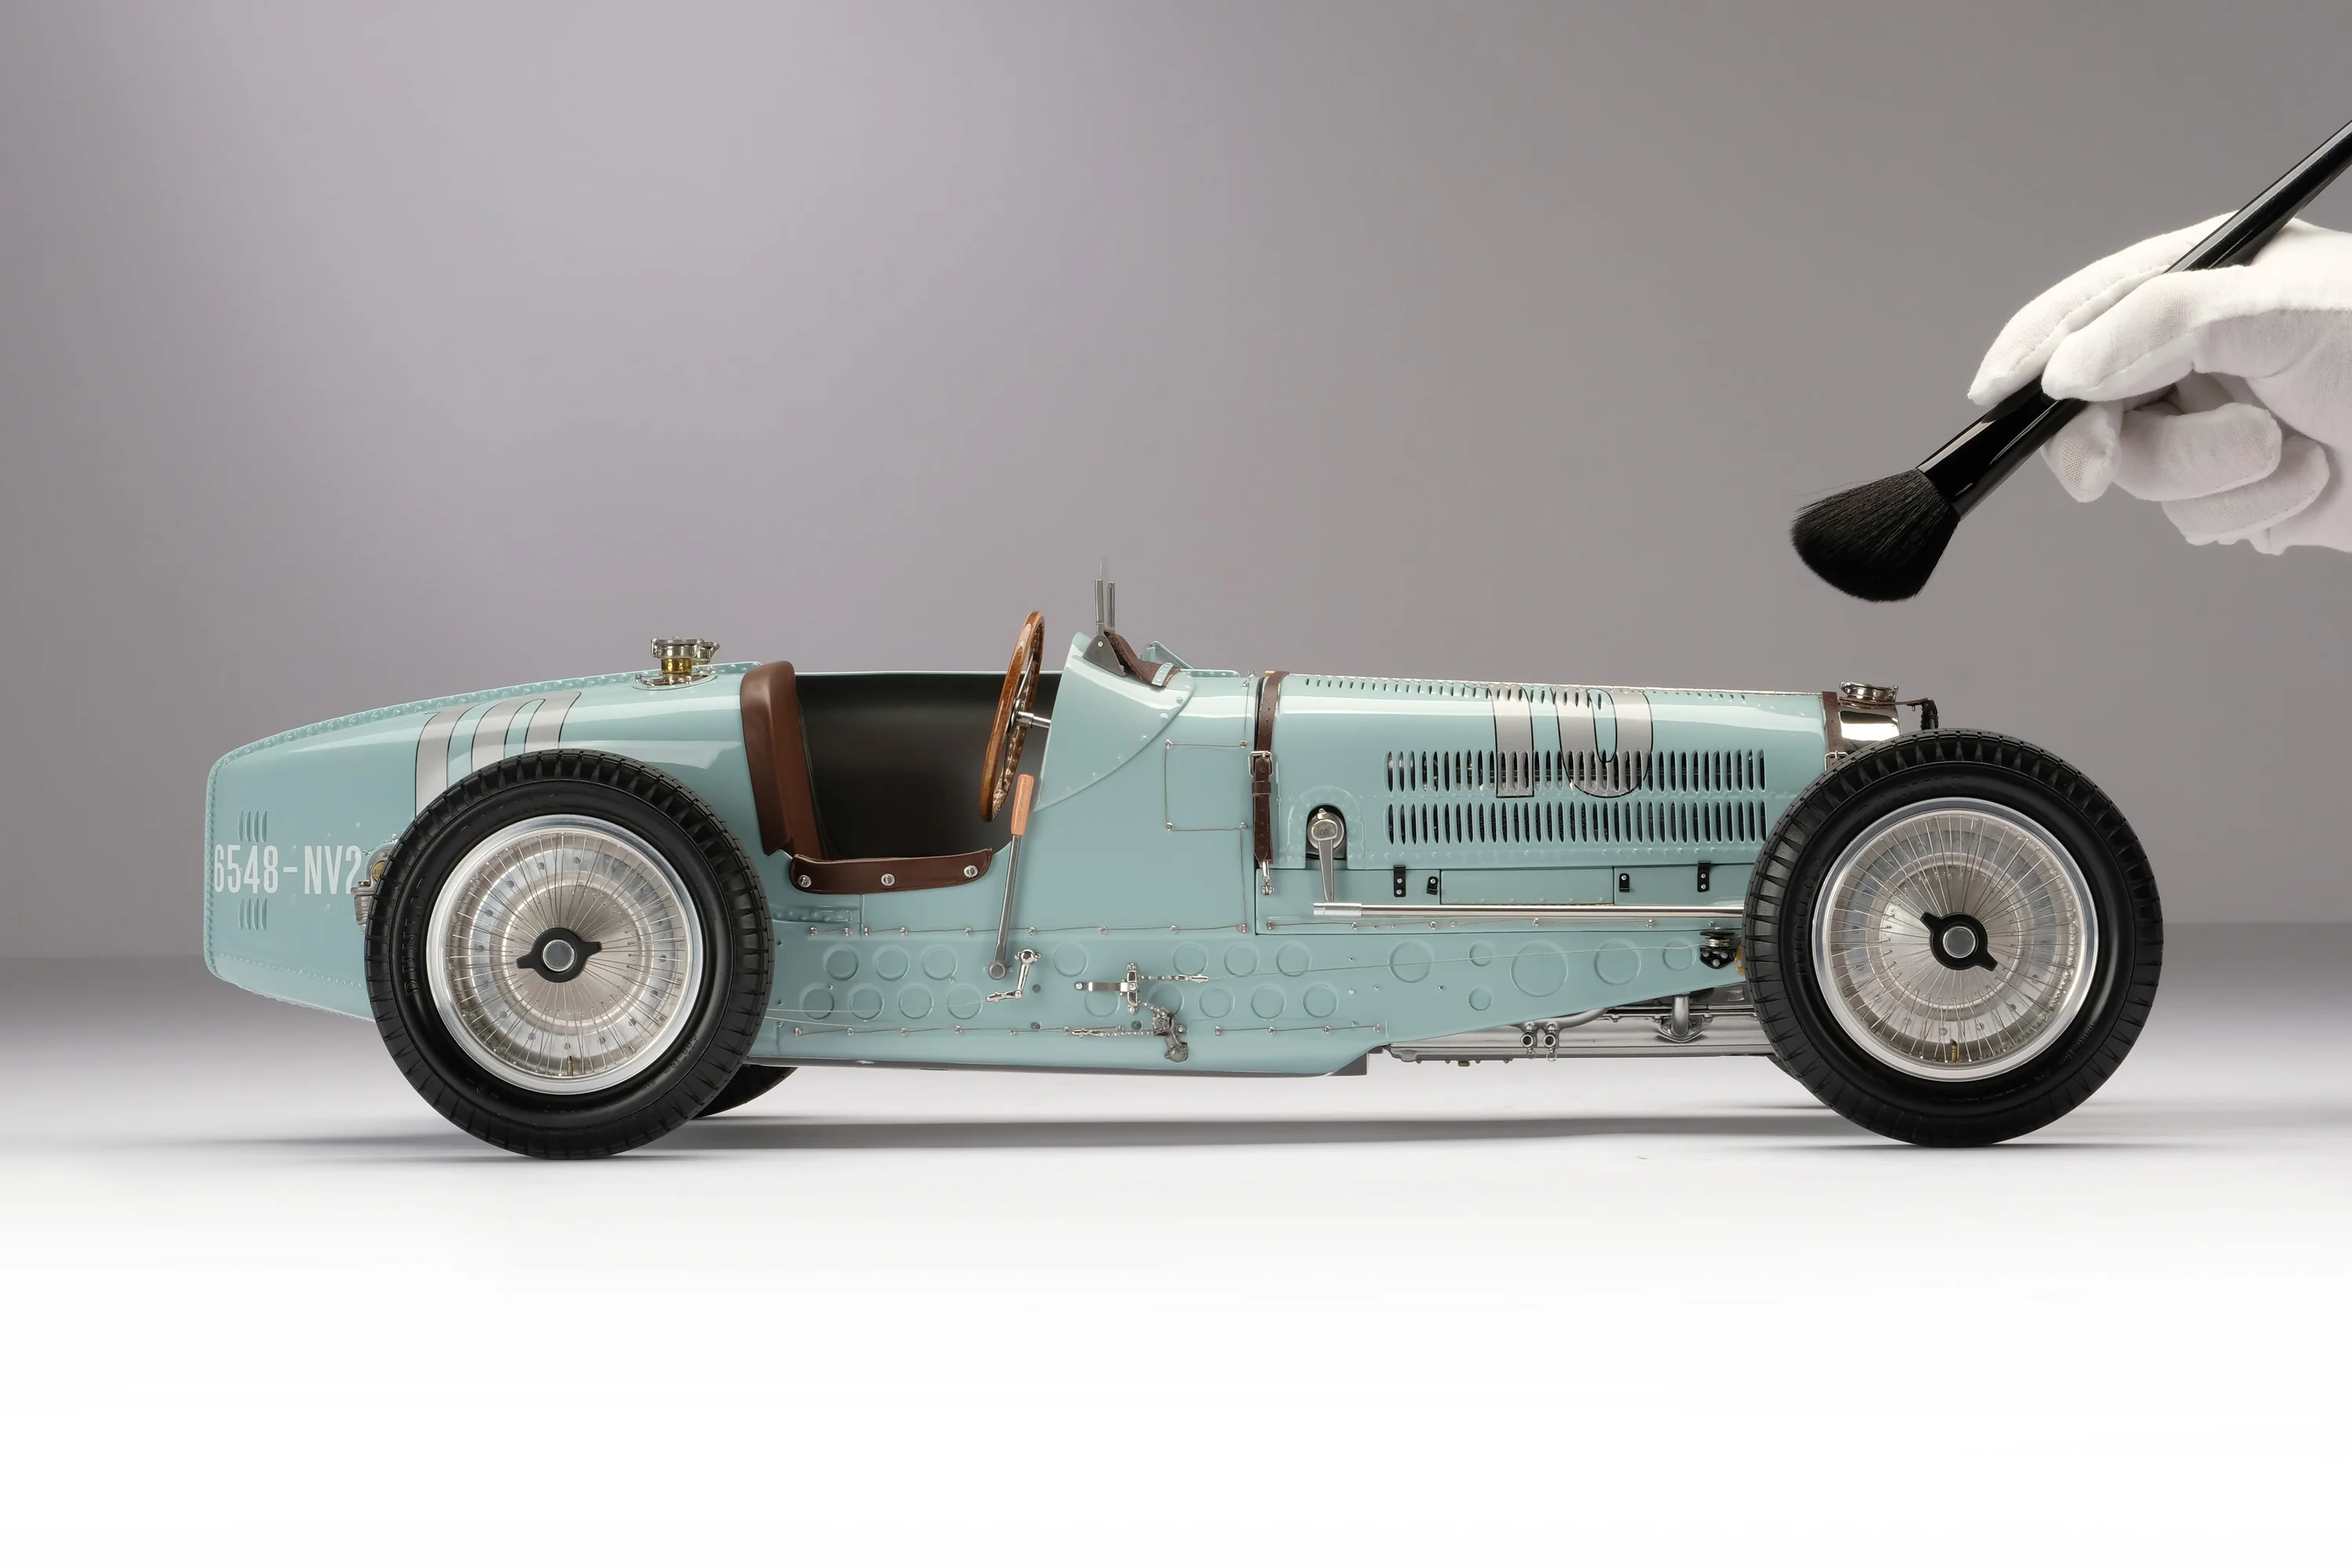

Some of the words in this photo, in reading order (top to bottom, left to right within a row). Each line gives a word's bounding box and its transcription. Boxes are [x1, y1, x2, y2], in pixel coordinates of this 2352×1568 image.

[1464, 681, 1653, 798] 10
[214, 844, 362, 895] 6548-NV2
[401, 877, 426, 996] DUNLO
